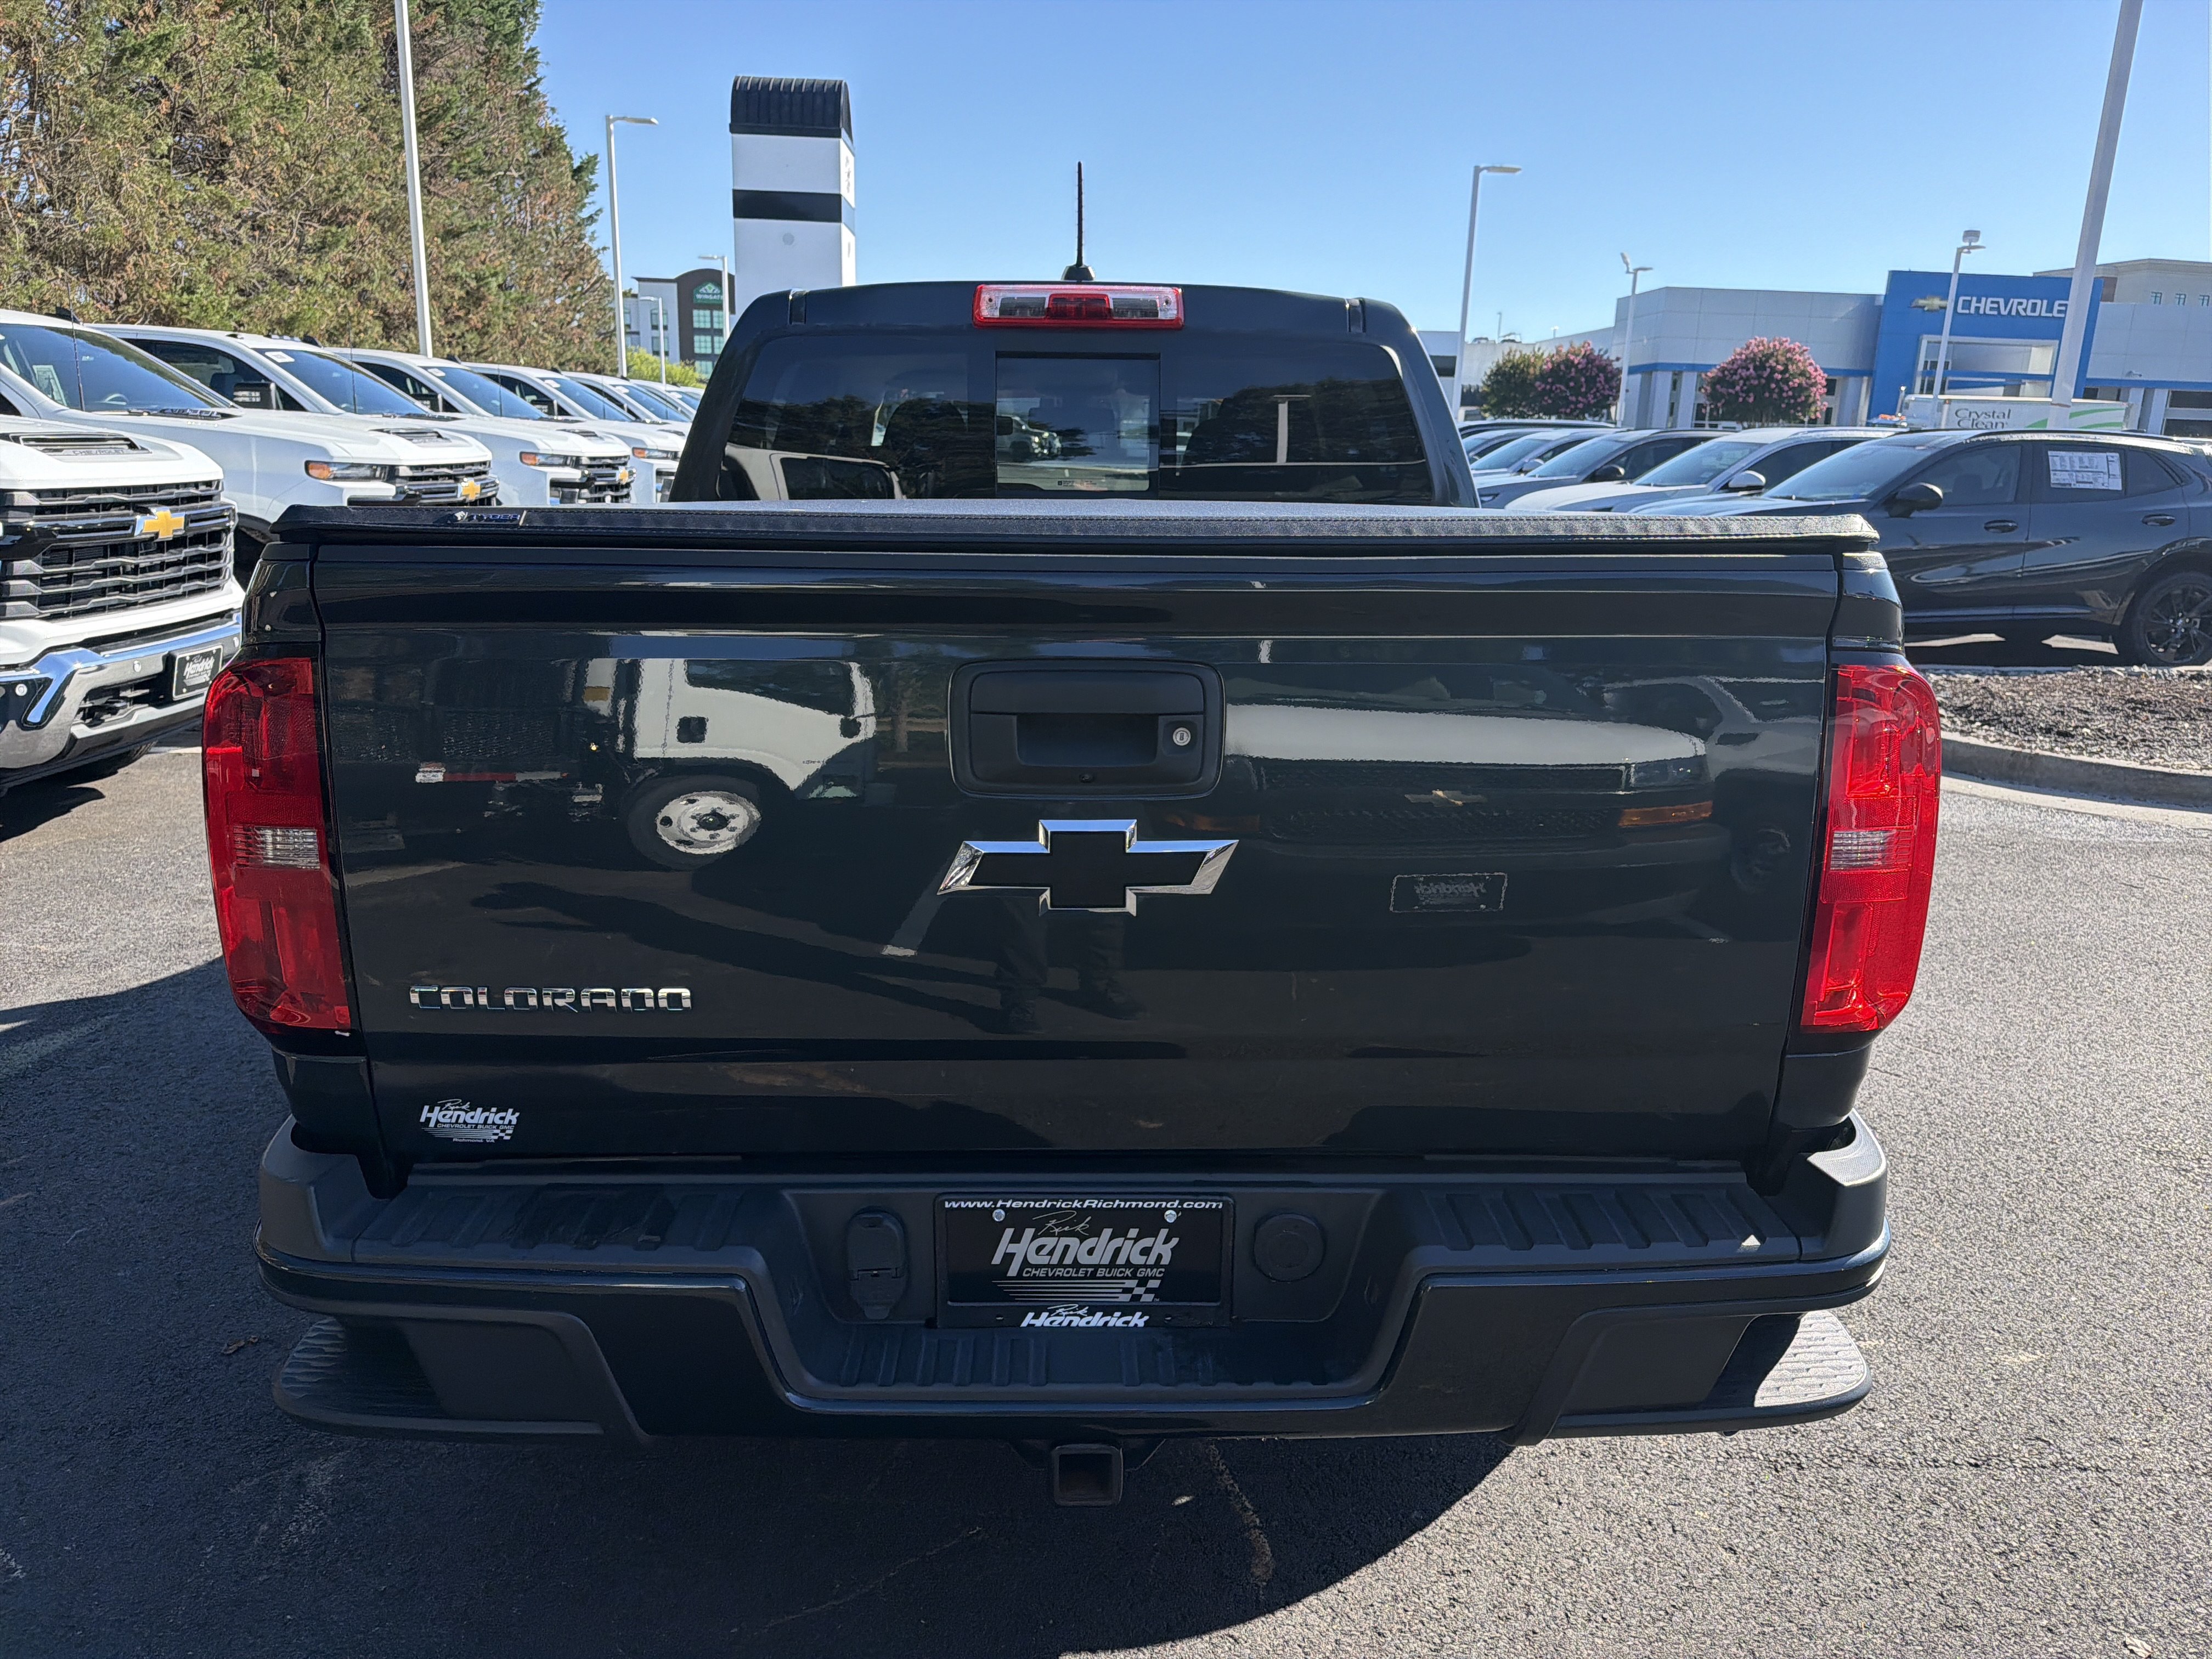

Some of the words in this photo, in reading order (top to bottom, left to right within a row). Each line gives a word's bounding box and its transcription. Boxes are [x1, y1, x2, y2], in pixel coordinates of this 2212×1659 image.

[1957, 296, 2069, 317] CHEVROLE
[1955, 408, 2011, 421] Crystal
[1957, 419, 2005, 429] Clean
[410, 985, 692, 1013] COLORADO
[420, 1105, 520, 1127] Hendrick
[945, 1199, 1223, 1209] www.HendrickRichmond.com
[991, 1228, 1180, 1277] Hendrick
[1023, 1267, 1094, 1277] CHEVROLET
[1096, 1267, 1134, 1277] BUICK
[1137, 1267, 1165, 1277] GMC
[1020, 1311, 1150, 1328] Hendrick
